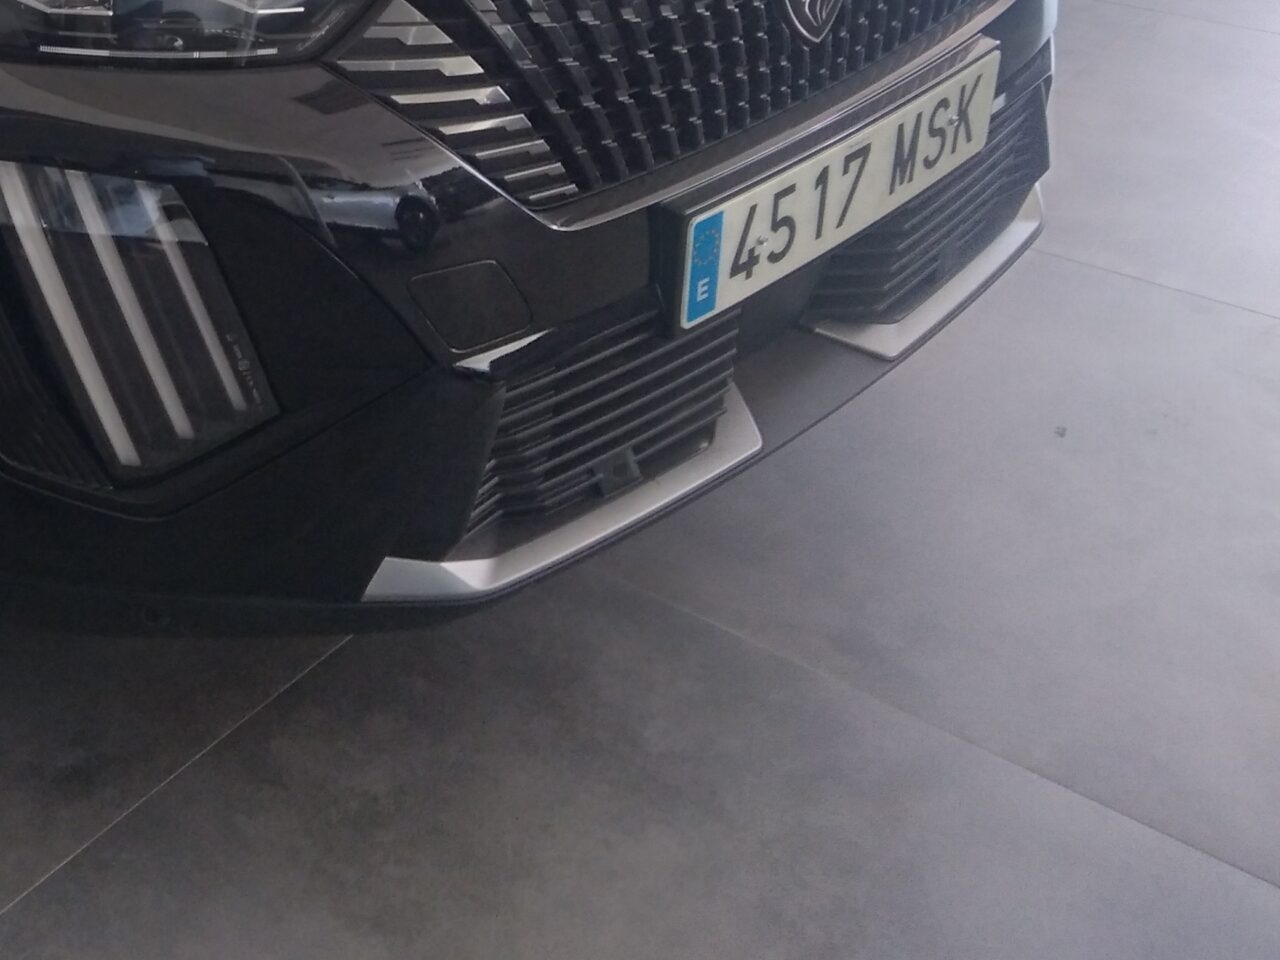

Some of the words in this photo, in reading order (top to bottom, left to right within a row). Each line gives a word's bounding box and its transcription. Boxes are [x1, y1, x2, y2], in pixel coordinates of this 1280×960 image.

[729, 142, 872, 280] 4517
[888, 73, 983, 195] MSK
[697, 277, 710, 302] E
